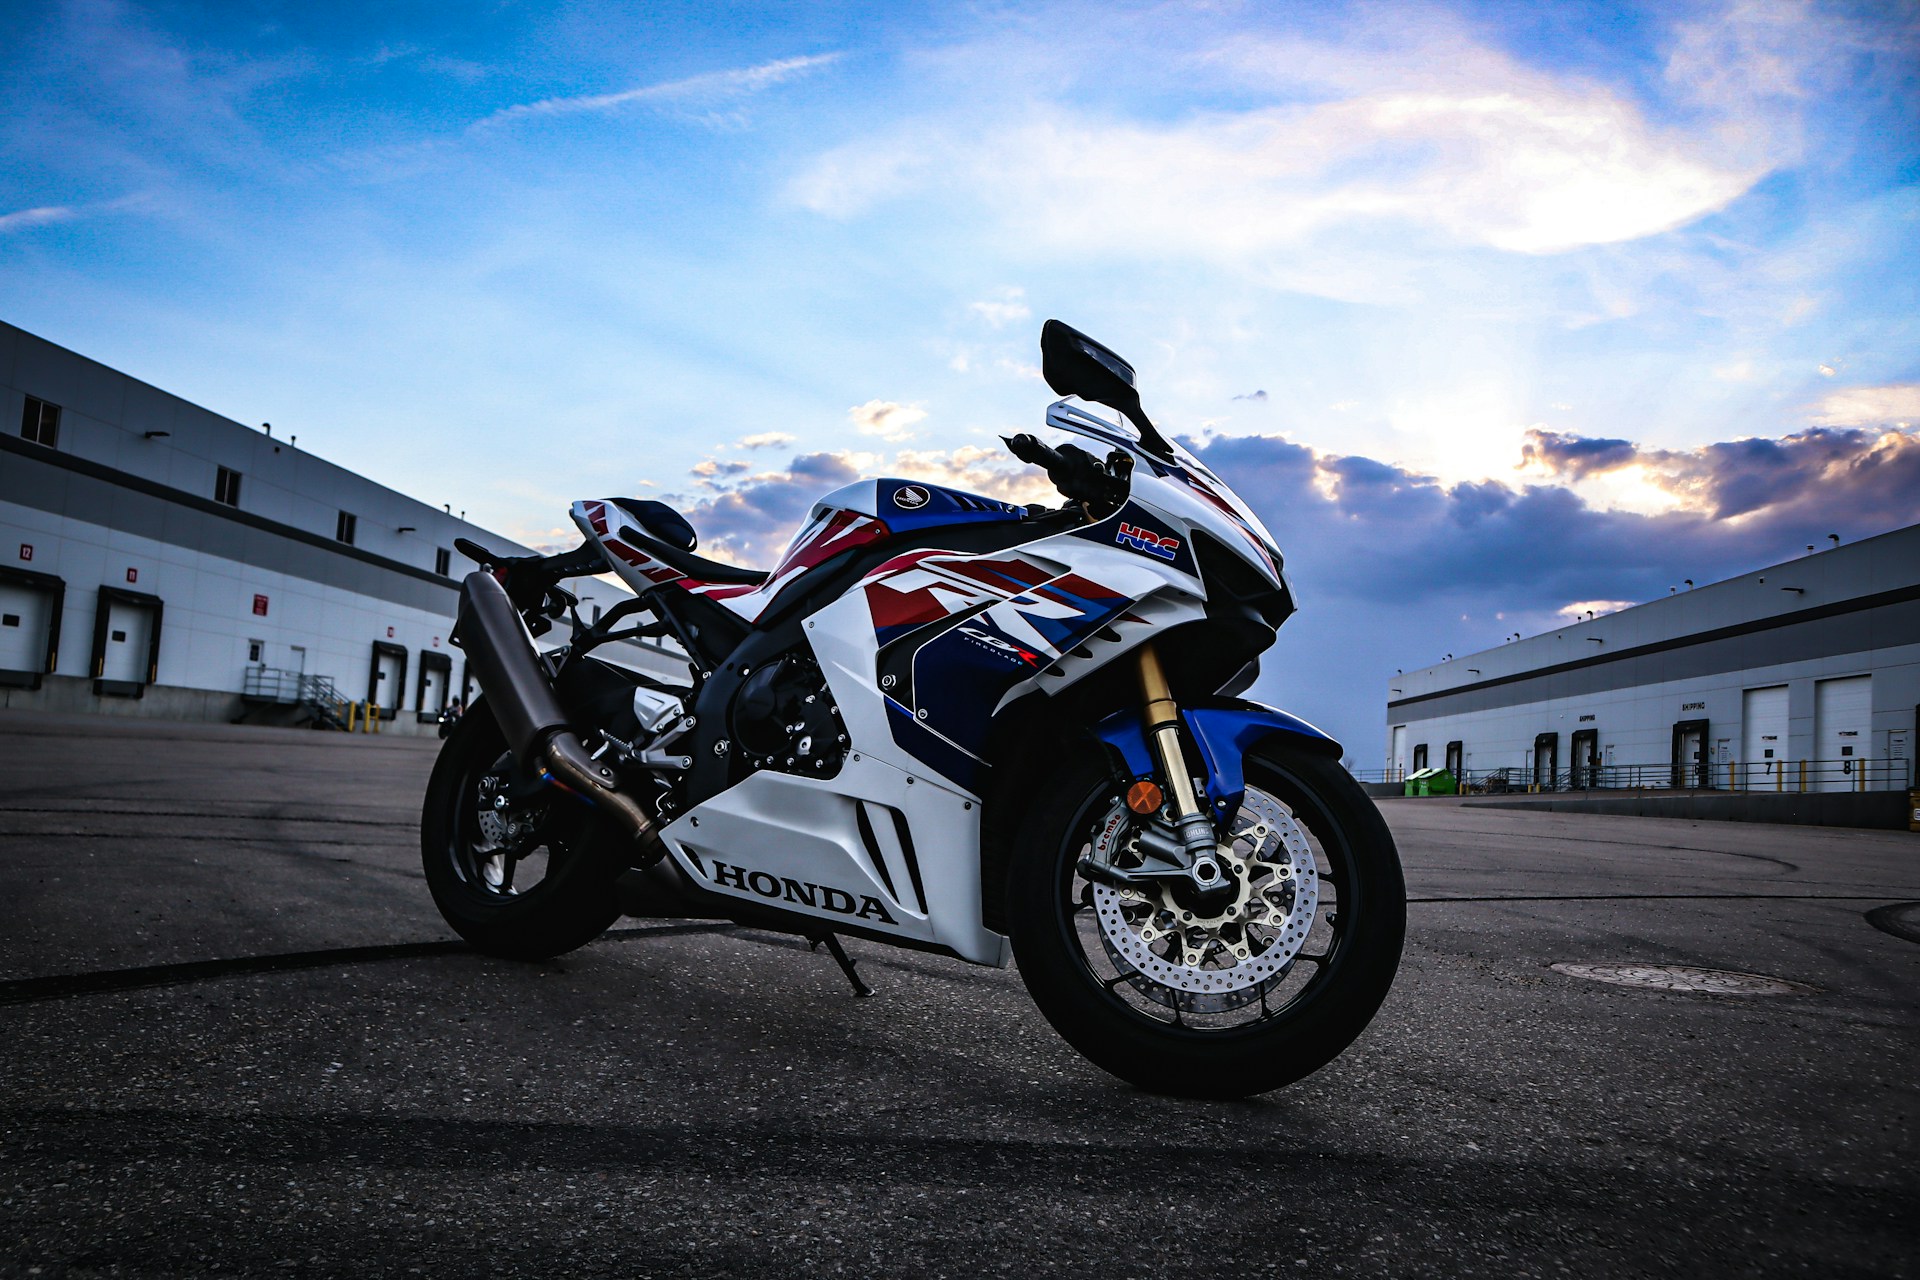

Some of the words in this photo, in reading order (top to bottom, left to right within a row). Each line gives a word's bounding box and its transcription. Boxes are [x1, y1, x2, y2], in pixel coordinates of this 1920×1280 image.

[1115, 522, 1180, 561] HRC
[22, 547, 31, 558] 12
[1682, 701, 1705, 712] SHIPPING
[1579, 714, 1596, 722] SHIPPING
[1765, 761, 1772, 775] 7
[1843, 760, 1852, 775] 8
[1098, 814, 1121, 851] brembo
[712, 860, 899, 925] HONDA
